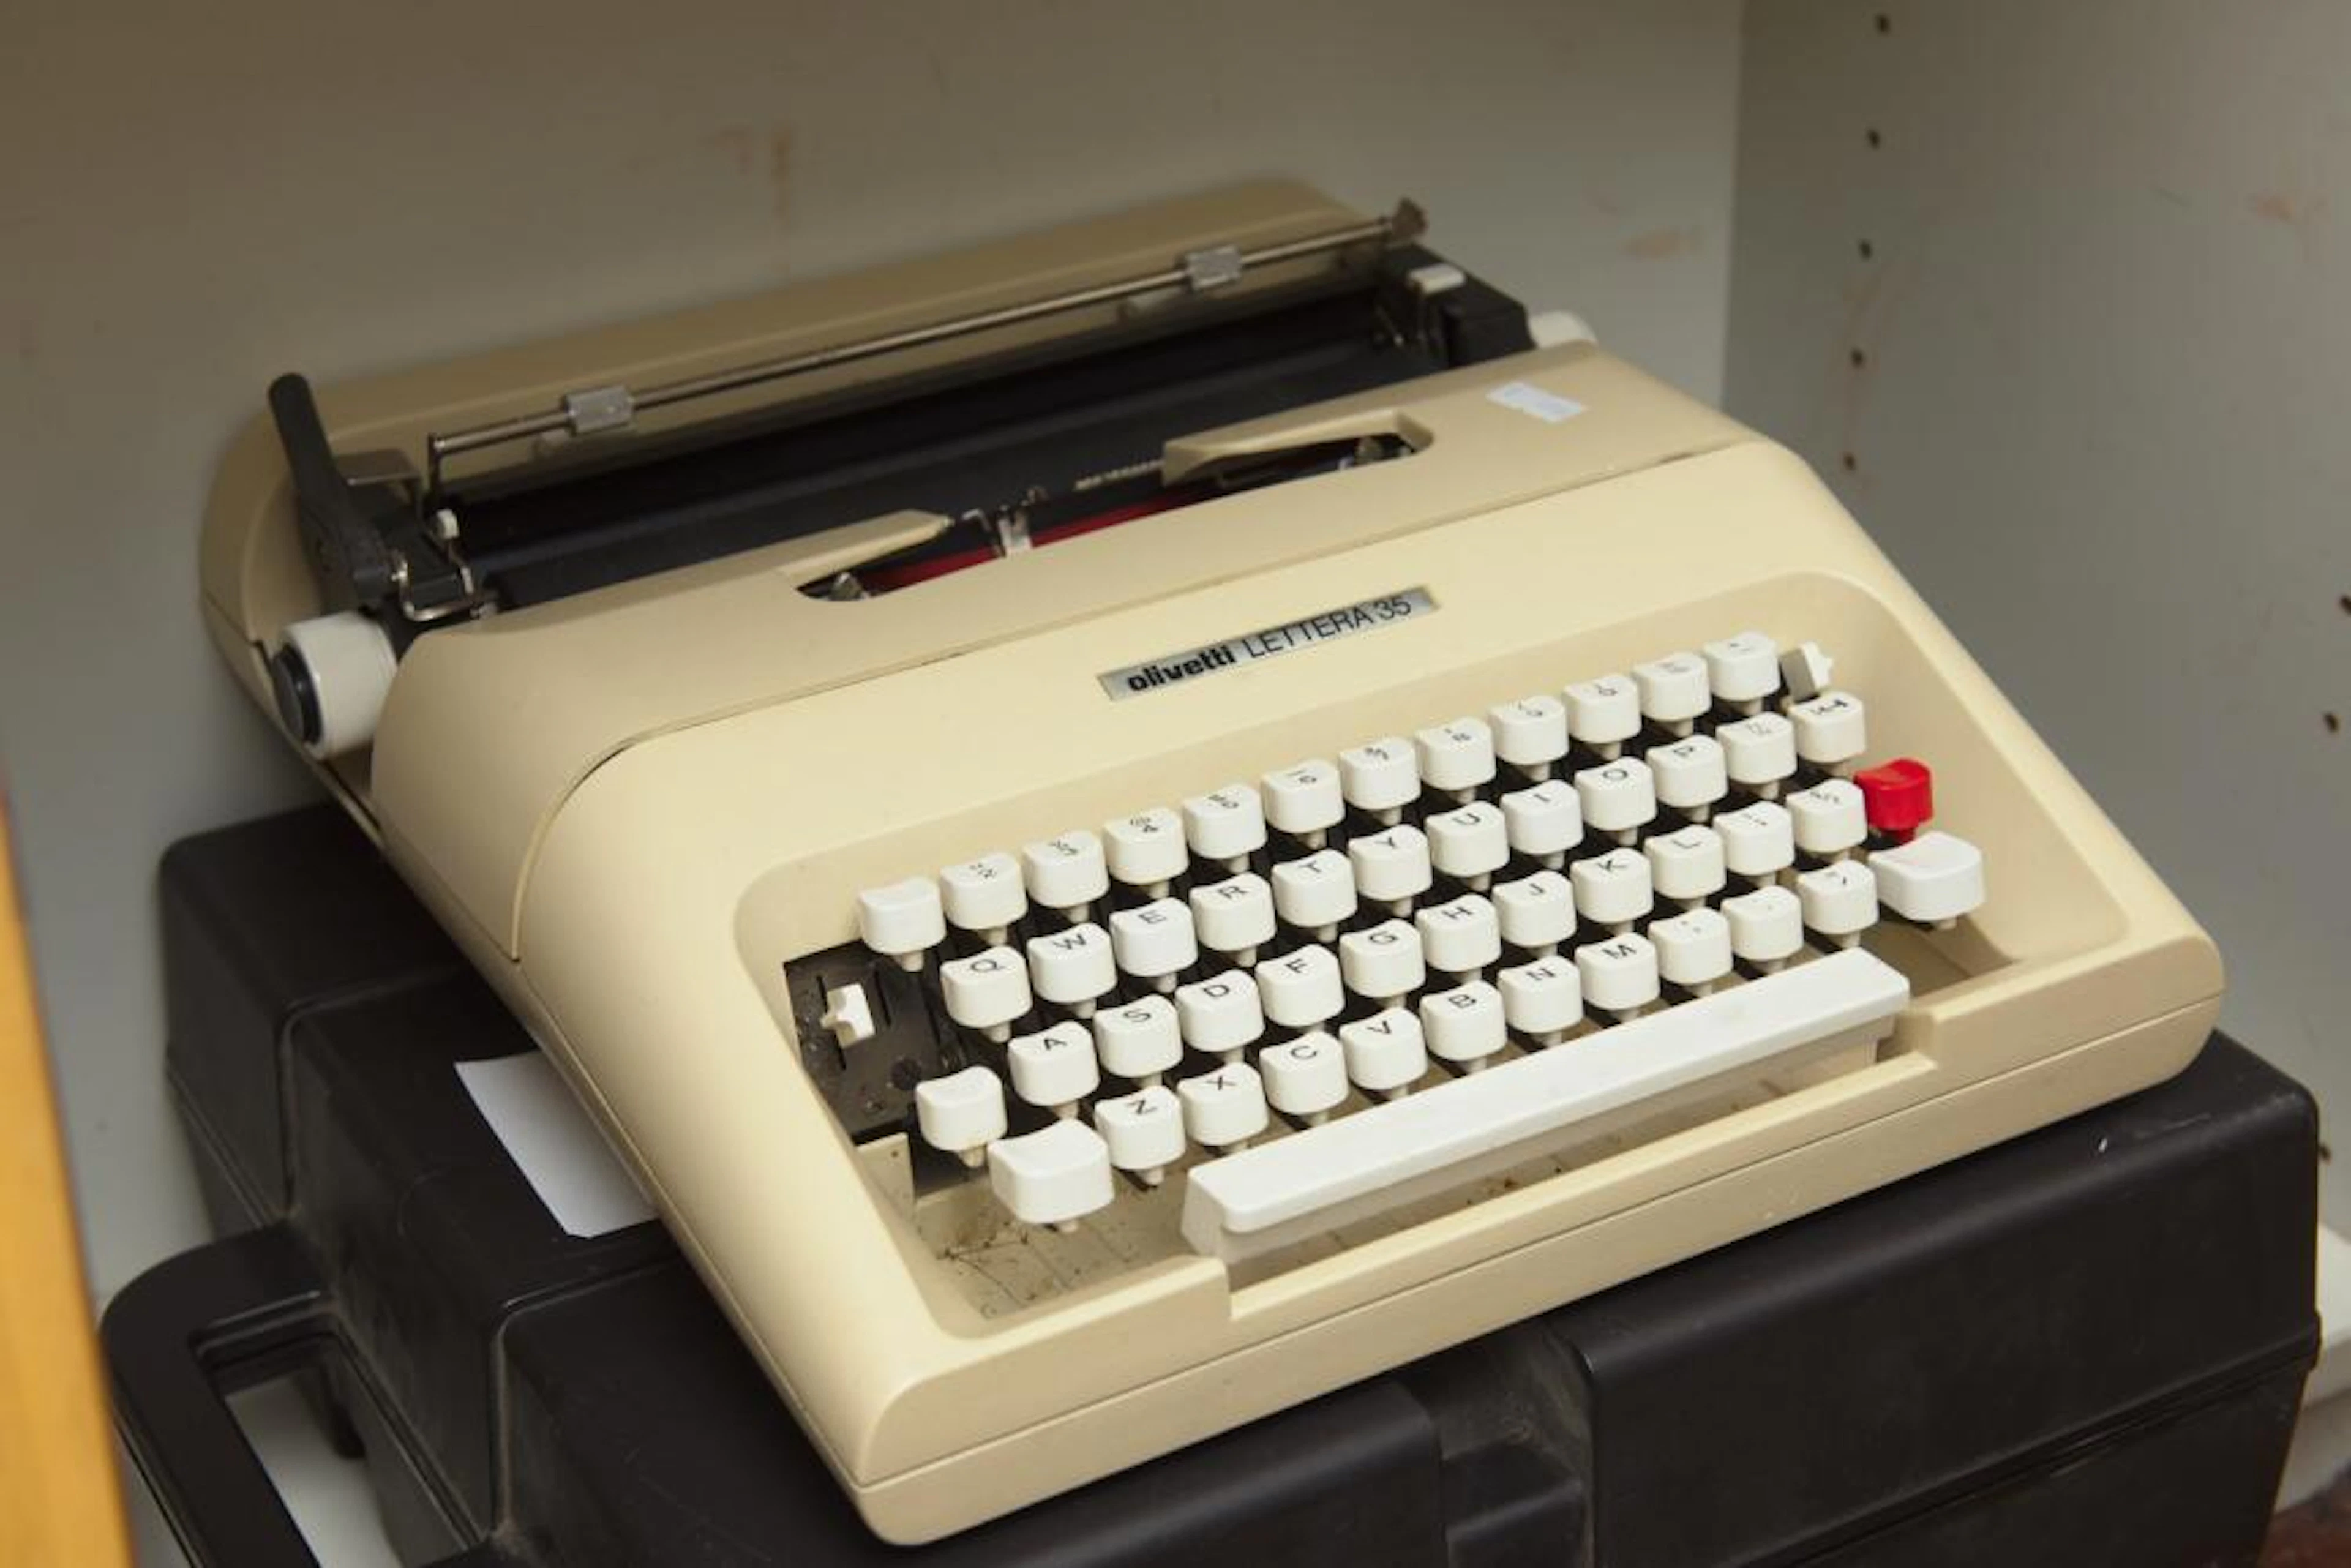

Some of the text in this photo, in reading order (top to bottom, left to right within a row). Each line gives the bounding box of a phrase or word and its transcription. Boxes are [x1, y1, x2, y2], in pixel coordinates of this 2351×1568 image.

[1127, 596, 1411, 692] olivetti LETTERA 35
[1453, 814, 1480, 825] U
[1374, 837, 1396, 849] Y
[1672, 838, 1701, 849] L
[1299, 860, 1322, 874] T
[1597, 858, 1627, 873] K
[1530, 883, 1544, 896] J
[1442, 906, 1472, 920] H
[1052, 934, 1086, 951] W
[1369, 932, 1397, 943] G
[1601, 943, 1637, 959] M
[971, 959, 1005, 972] Q
[1286, 959, 1307, 973] F
[1204, 985, 1229, 997] D
[1123, 1009, 1152, 1022] S
[1367, 1021, 1392, 1035] V
[1044, 1037, 1067, 1051] A
[1291, 1046, 1318, 1060] C
[1206, 1075, 1235, 1090] X
[1128, 1100, 1157, 1116] Z
